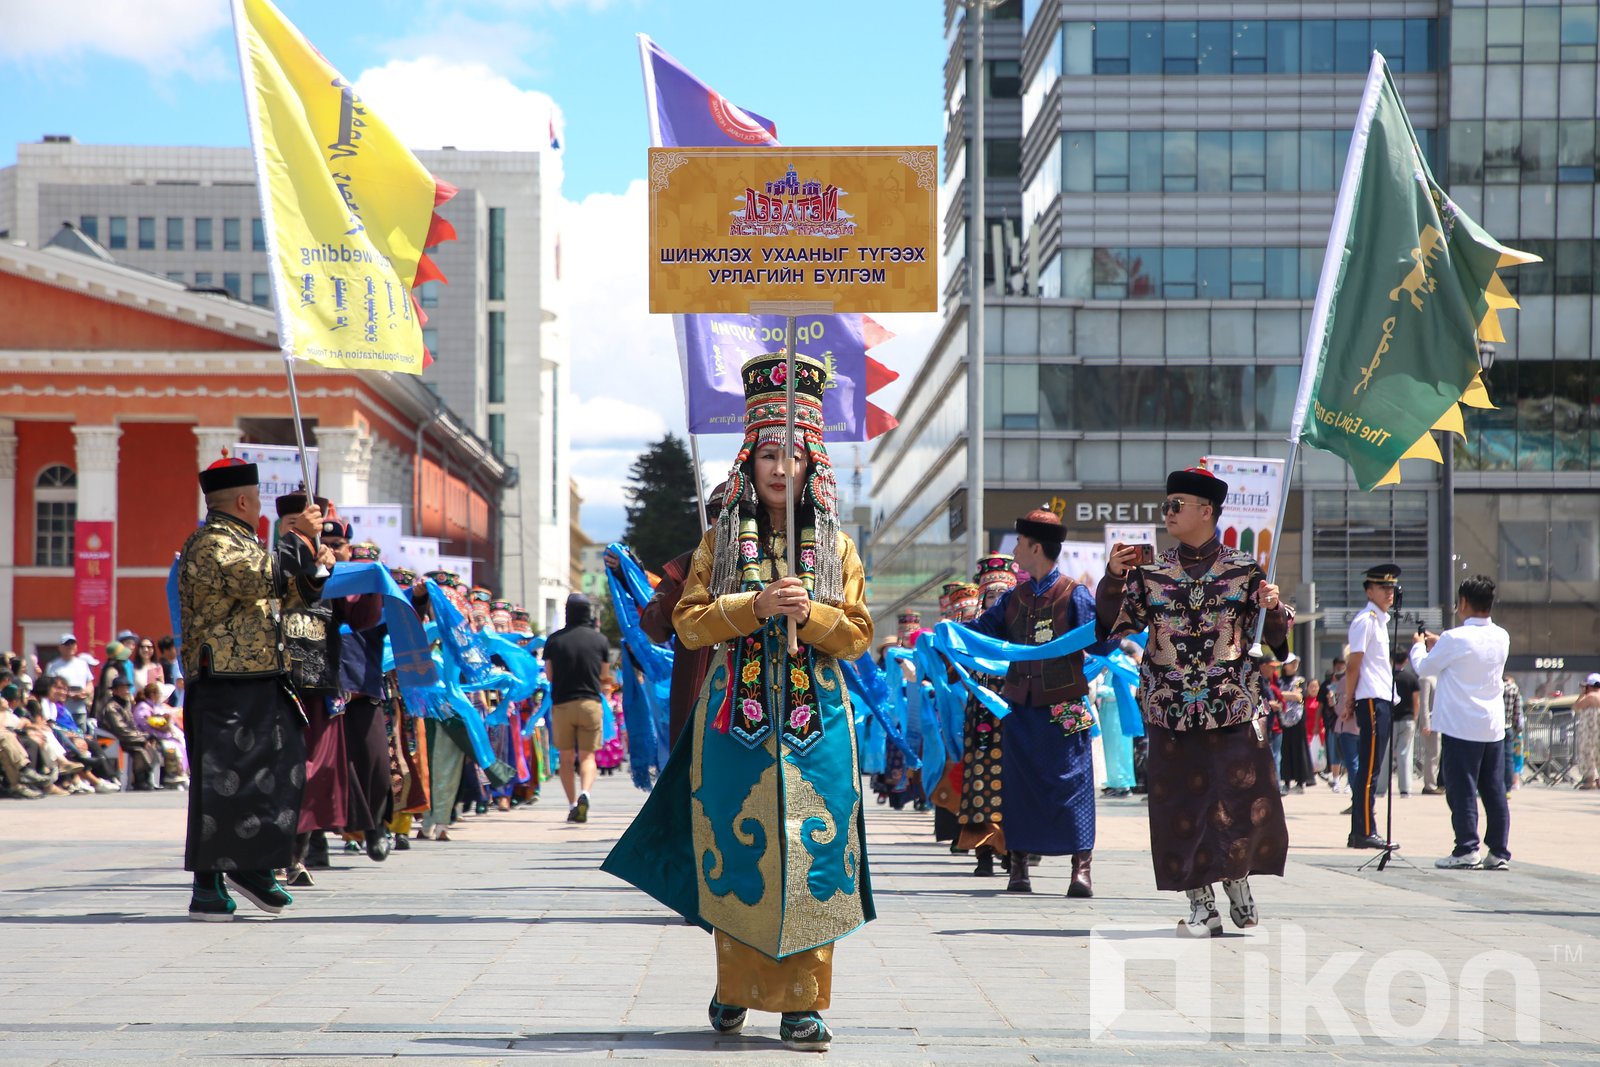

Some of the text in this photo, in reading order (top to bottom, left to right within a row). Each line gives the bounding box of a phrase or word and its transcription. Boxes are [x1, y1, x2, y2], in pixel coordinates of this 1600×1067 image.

[660, 248, 925, 263] ШИНЖЛЭХ УХААНЫГ ТҮГЭЭХ
[708, 267, 886, 284] УРЛАГИЙН БҮЛГЭМ
[1076, 502, 1166, 521] BREIT
[1535, 657, 1564, 669] BOSS
